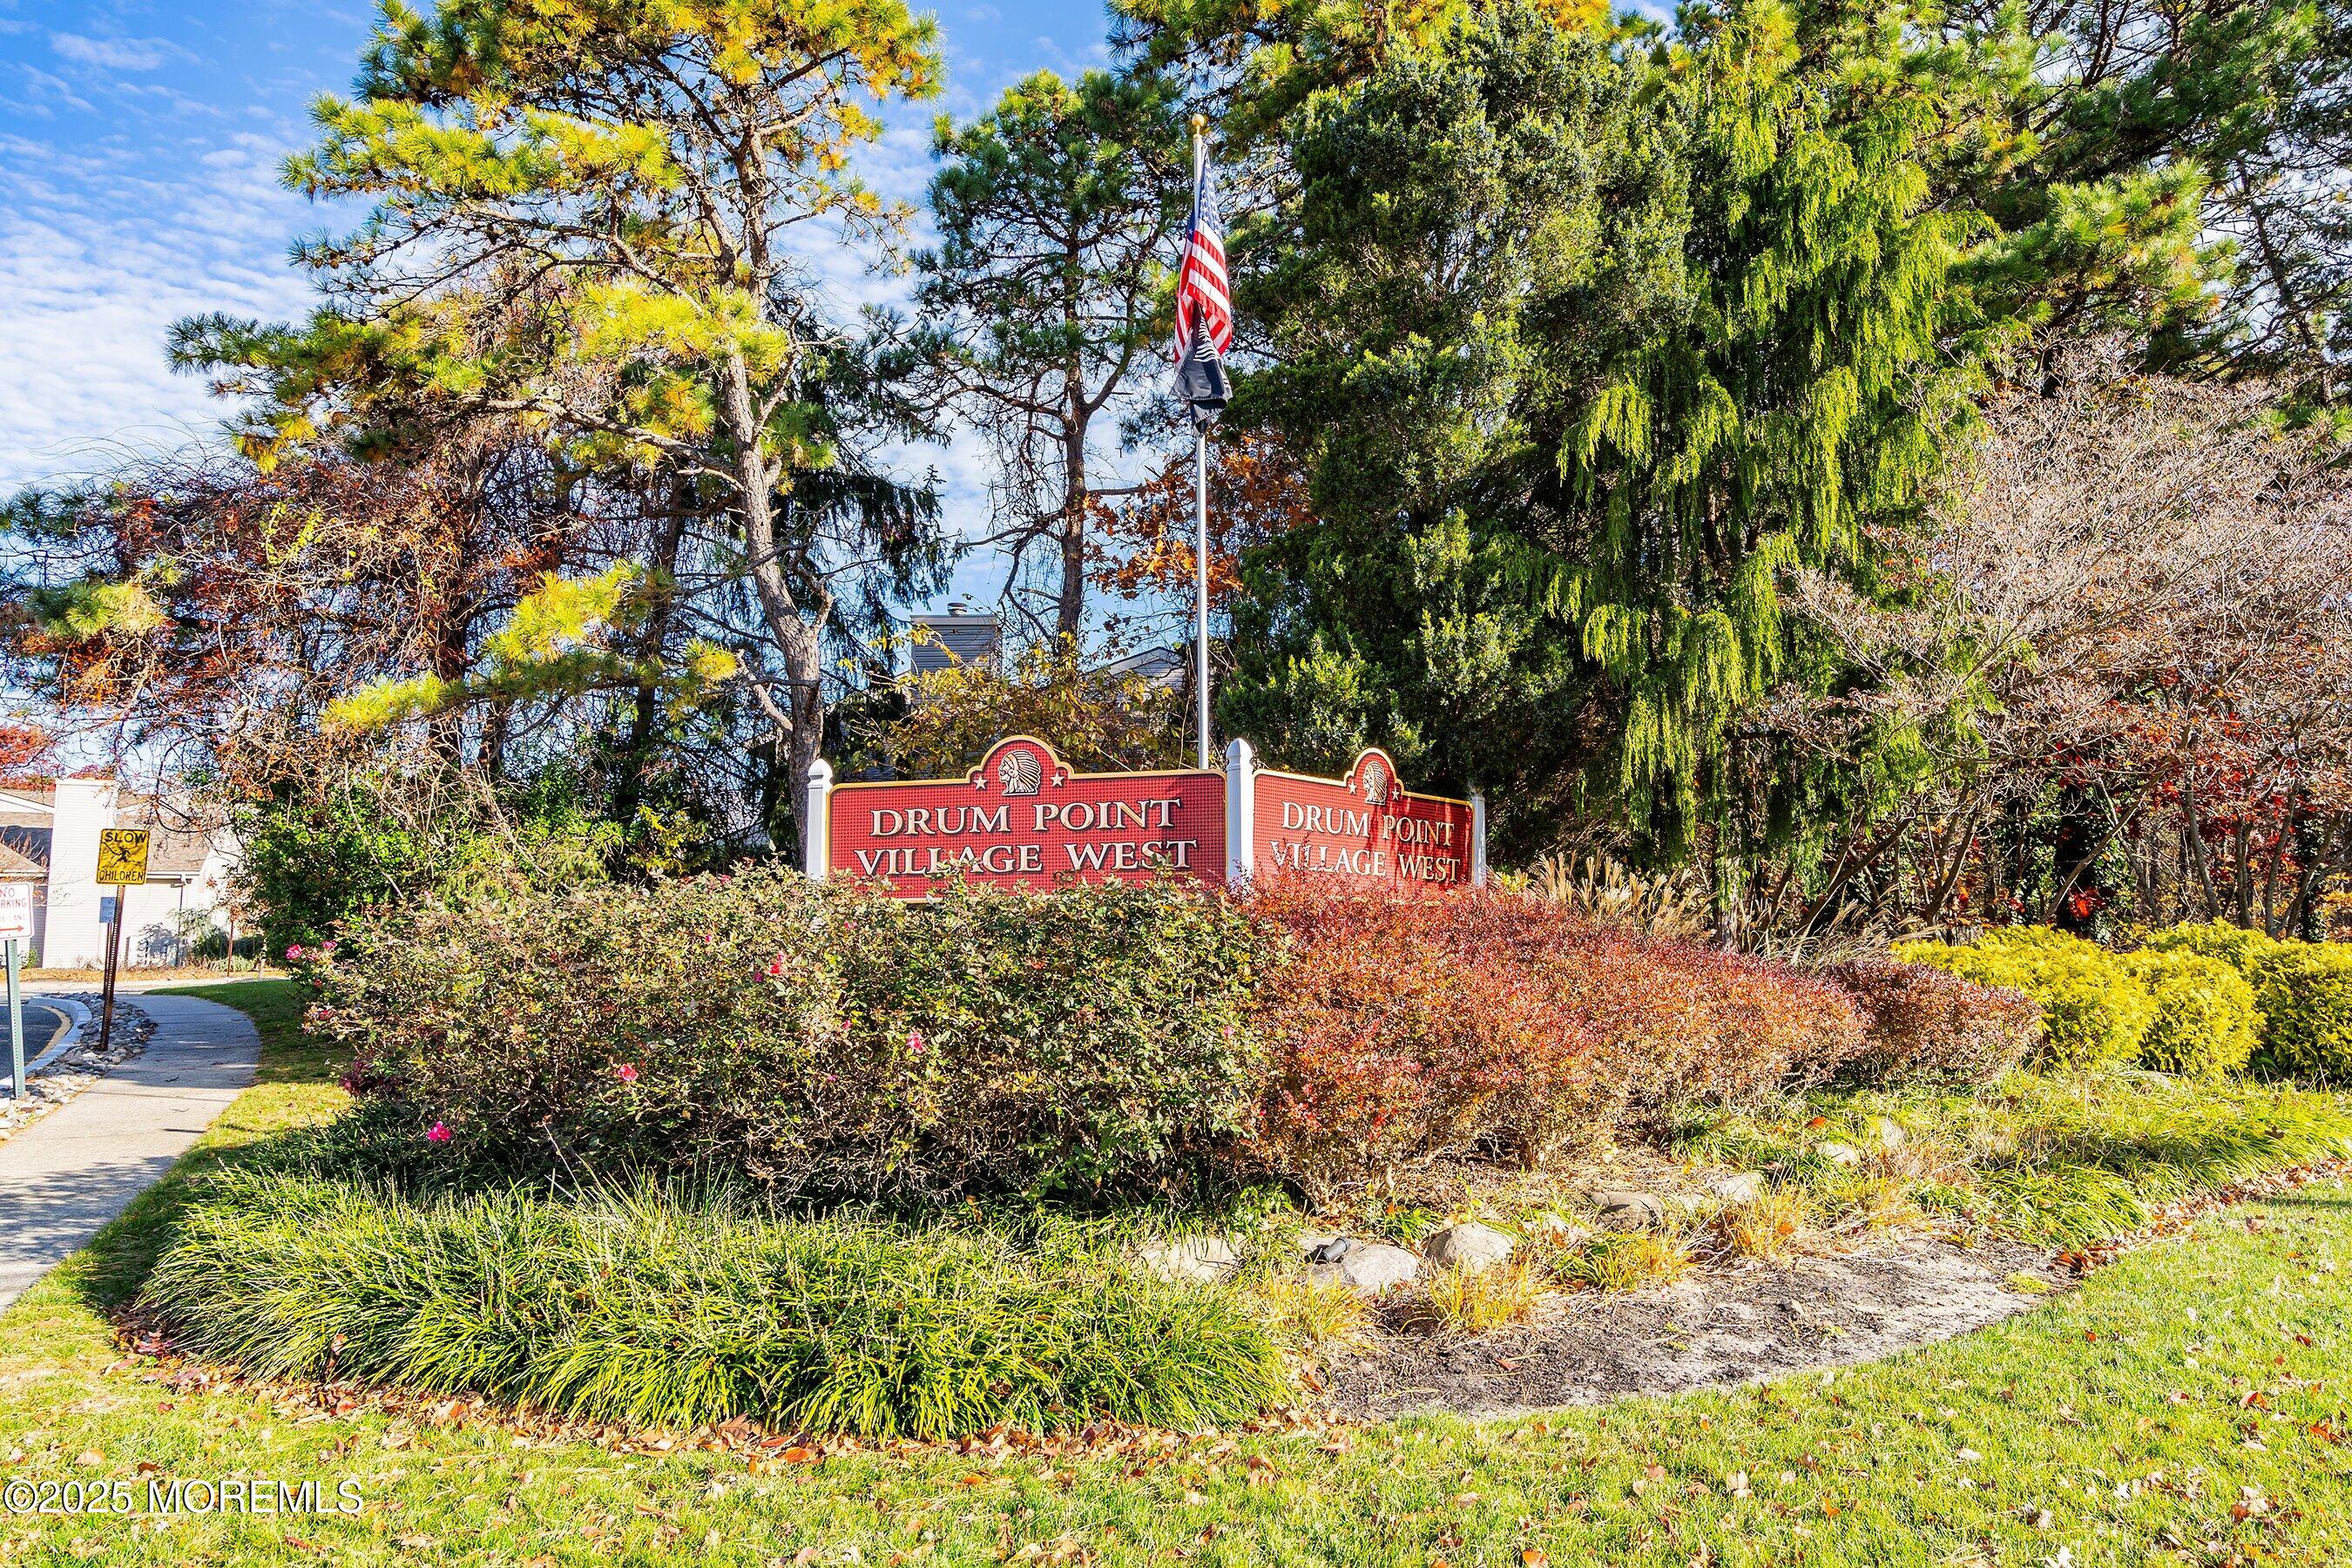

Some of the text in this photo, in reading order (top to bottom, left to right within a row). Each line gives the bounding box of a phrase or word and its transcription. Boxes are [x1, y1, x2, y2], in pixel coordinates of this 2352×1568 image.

[870, 798, 1181, 838] DRUM POINT
[1281, 801, 1455, 848] DRUM POINT
[105, 832, 146, 843] SLOW
[854, 839, 1198, 875] VILLAGE WEST
[1269, 839, 1461, 882] VILLAGE WEST
[99, 870, 144, 881] CHILDREN
[0, 888, 15, 897] NO
[0, 898, 26, 908] RKING
